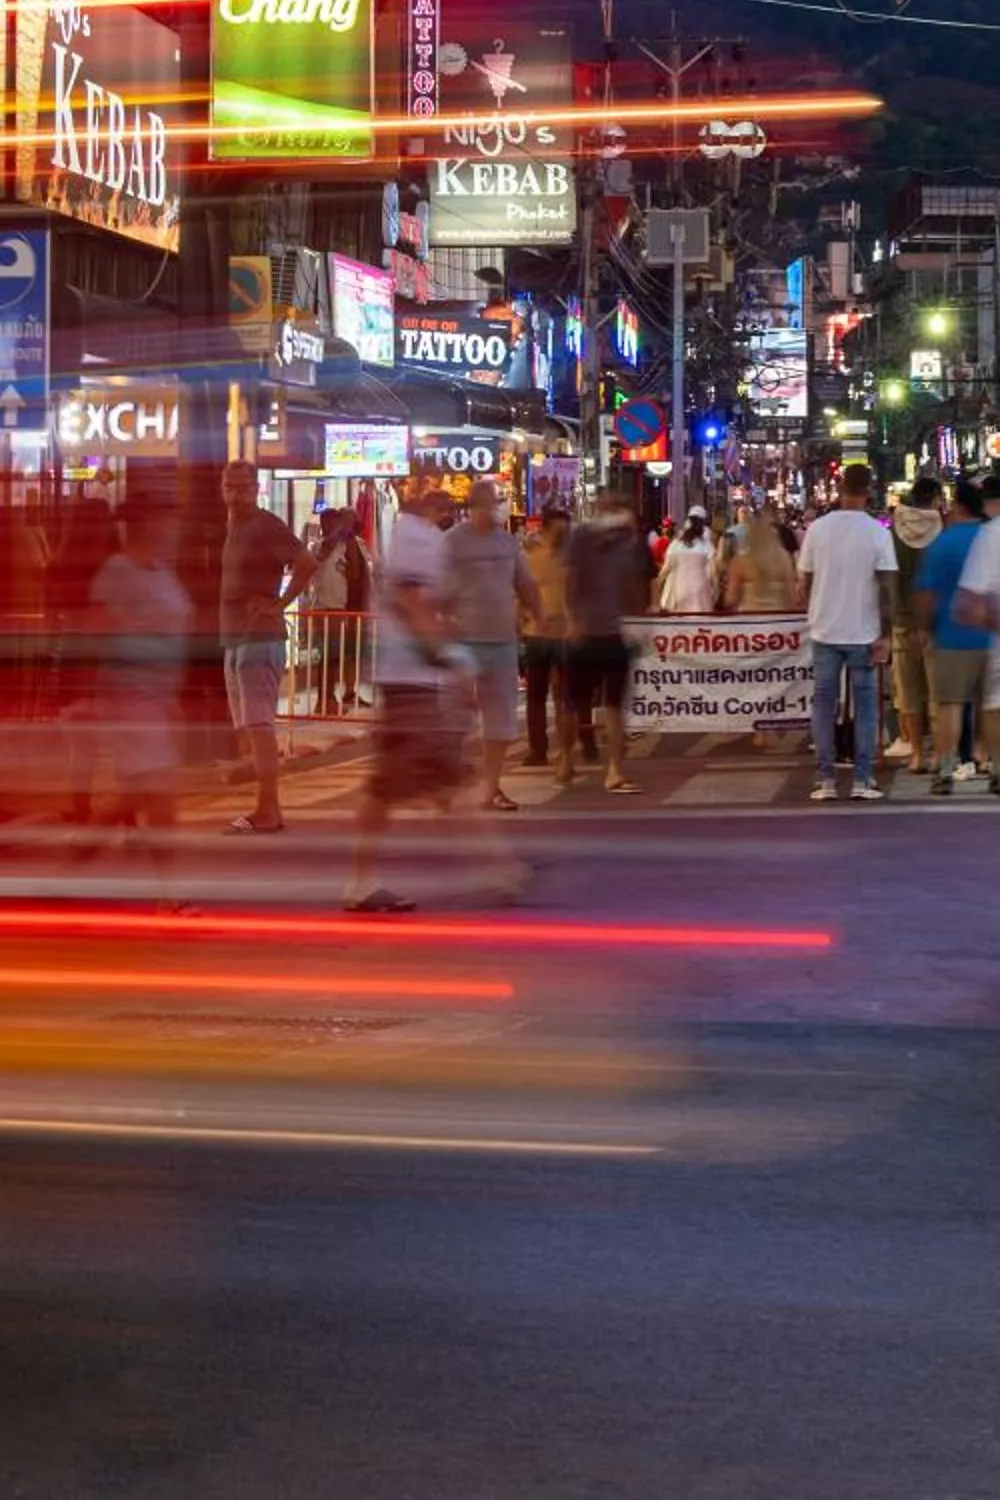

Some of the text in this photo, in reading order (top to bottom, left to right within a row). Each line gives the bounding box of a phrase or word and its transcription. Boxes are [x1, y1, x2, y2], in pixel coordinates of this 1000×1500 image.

[52, 42, 166, 206] KEBAB
[435, 158, 570, 197] KEBAB
[400, 329, 507, 367] TATTOO
[653, 628, 801, 662] จุดคัดกรอง
[723, 696, 813, 716] Covid-1
